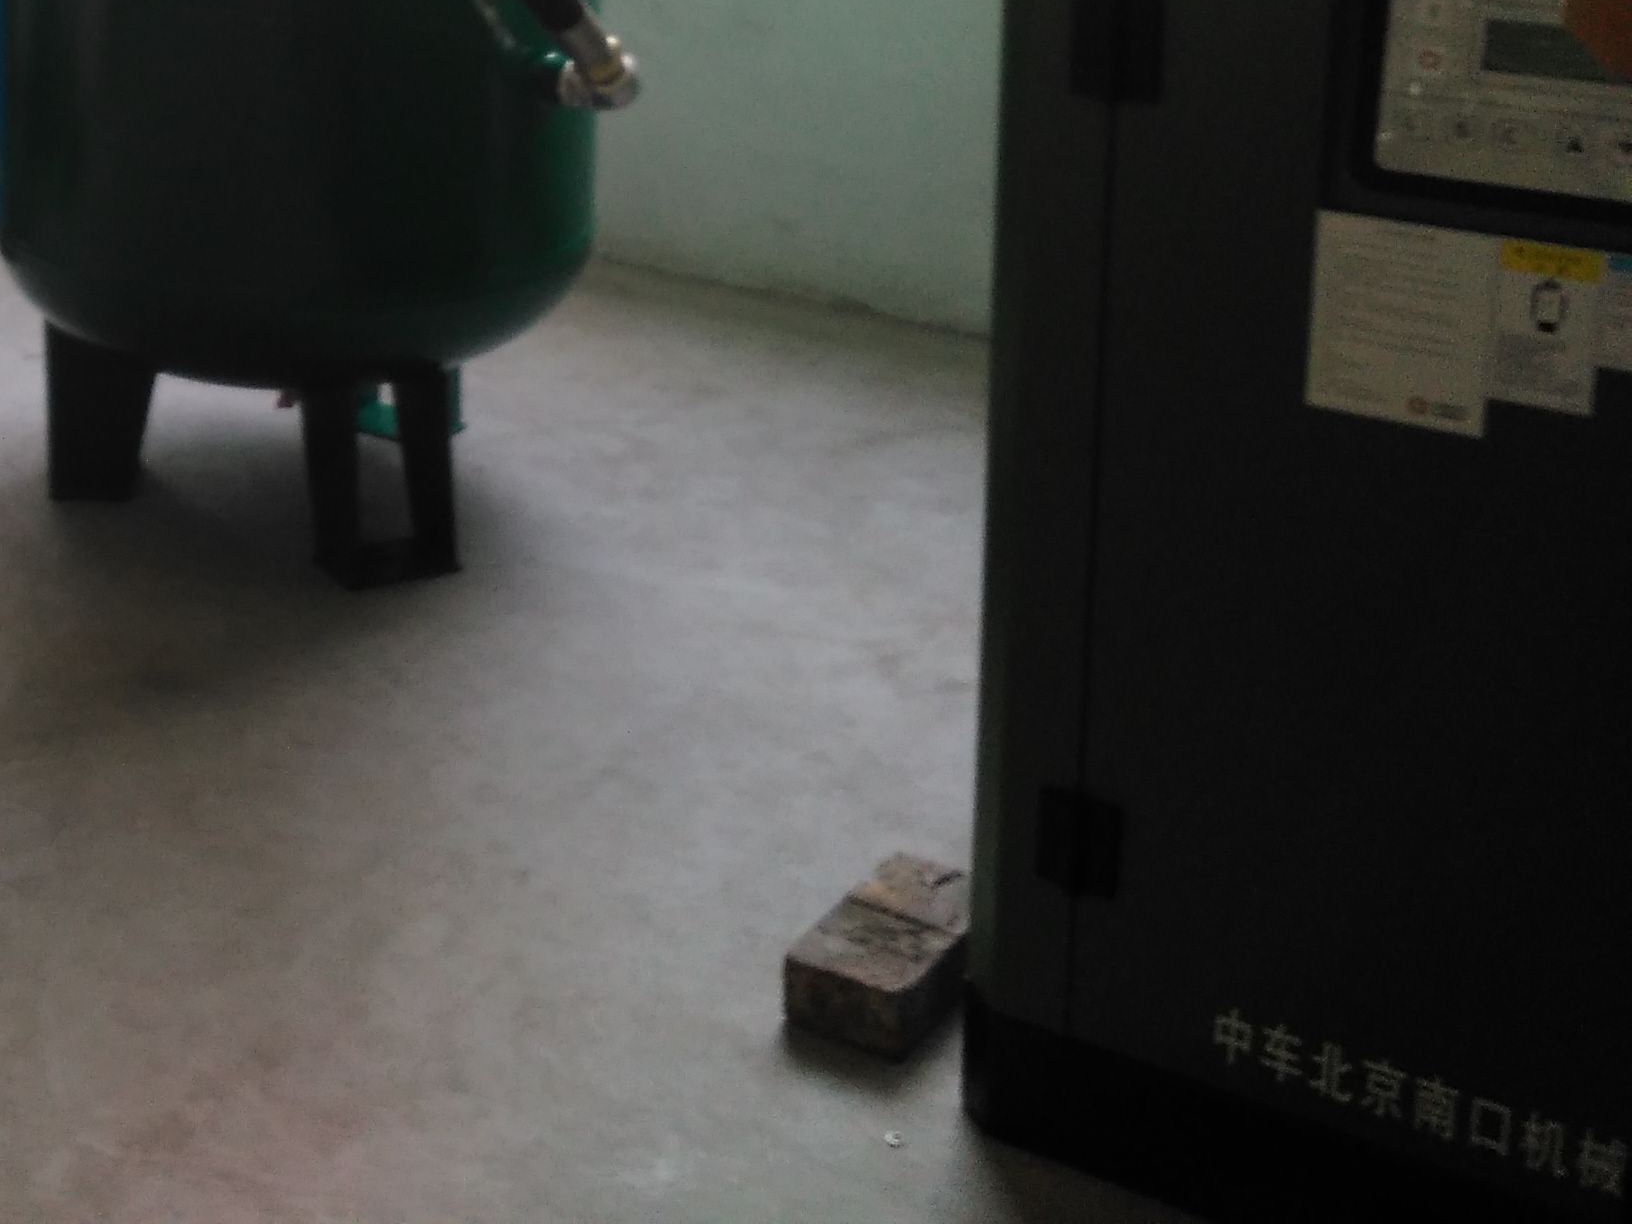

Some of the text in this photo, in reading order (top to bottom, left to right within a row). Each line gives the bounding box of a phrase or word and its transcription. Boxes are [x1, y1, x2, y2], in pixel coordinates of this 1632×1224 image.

[1211, 1007, 1628, 1198] 中车北京南口机械
